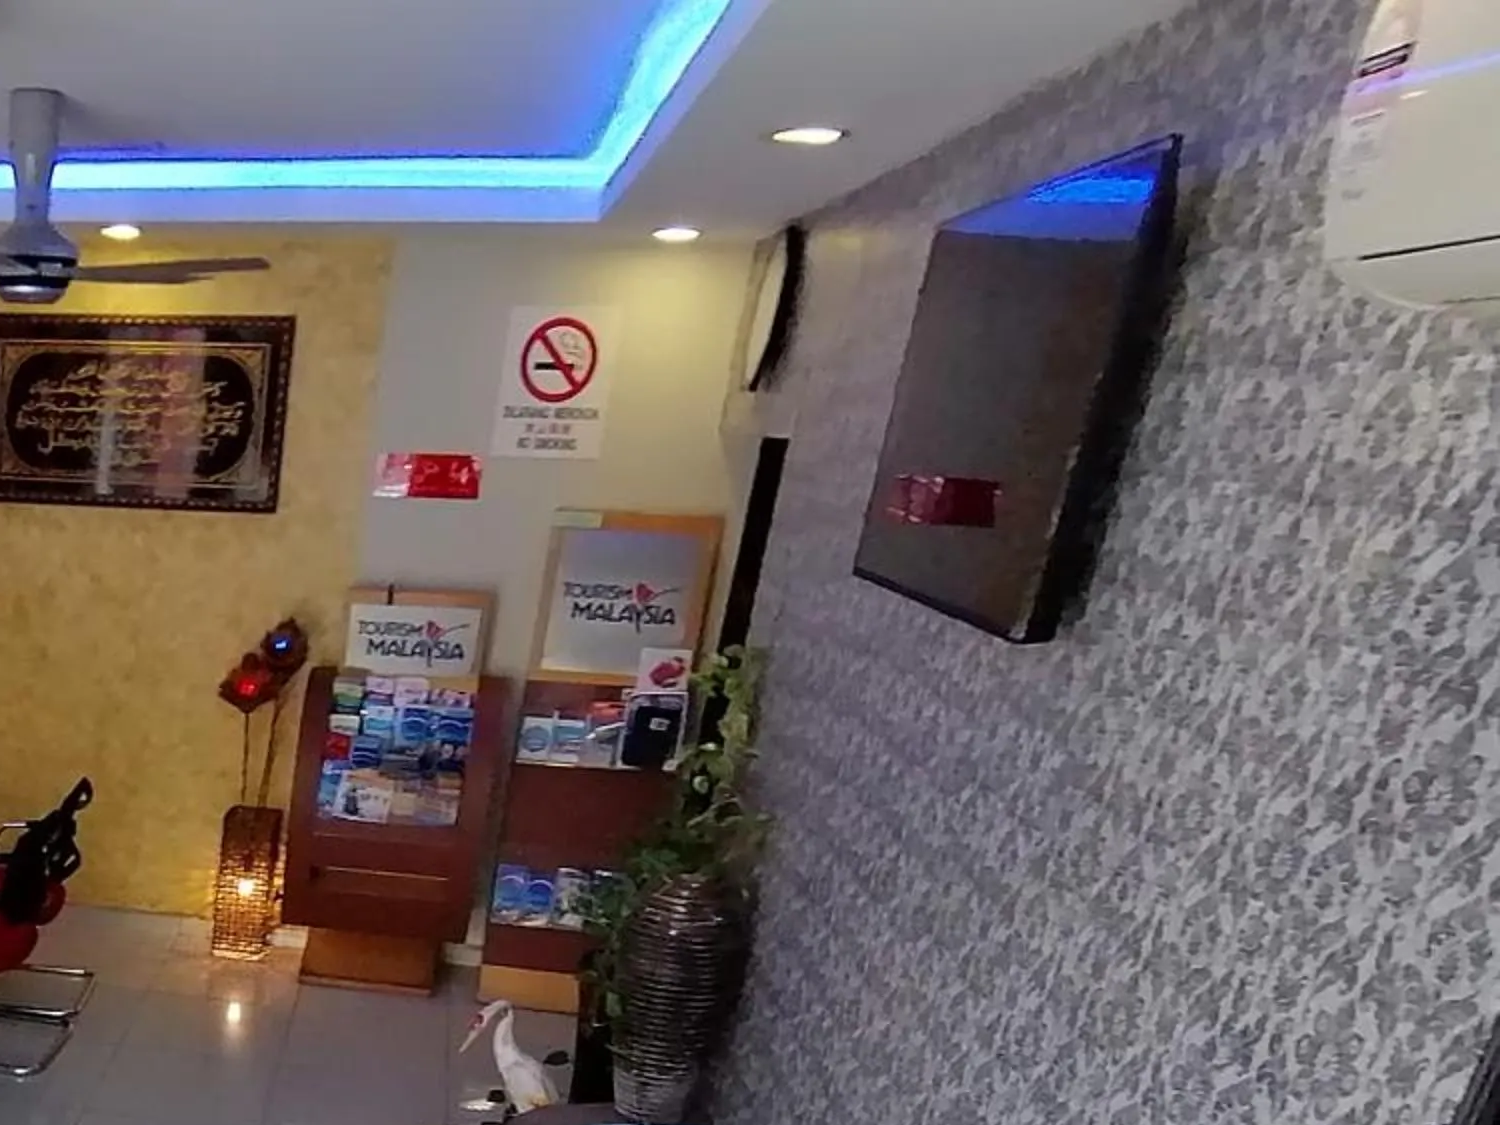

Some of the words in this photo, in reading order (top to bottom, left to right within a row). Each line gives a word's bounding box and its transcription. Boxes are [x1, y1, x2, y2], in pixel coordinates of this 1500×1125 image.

[563, 582, 633, 600] TOURISM
[358, 619, 425, 636] TOURISM
[570, 602, 675, 634] MALAYSIA
[365, 638, 465, 667] MALAYSIA
